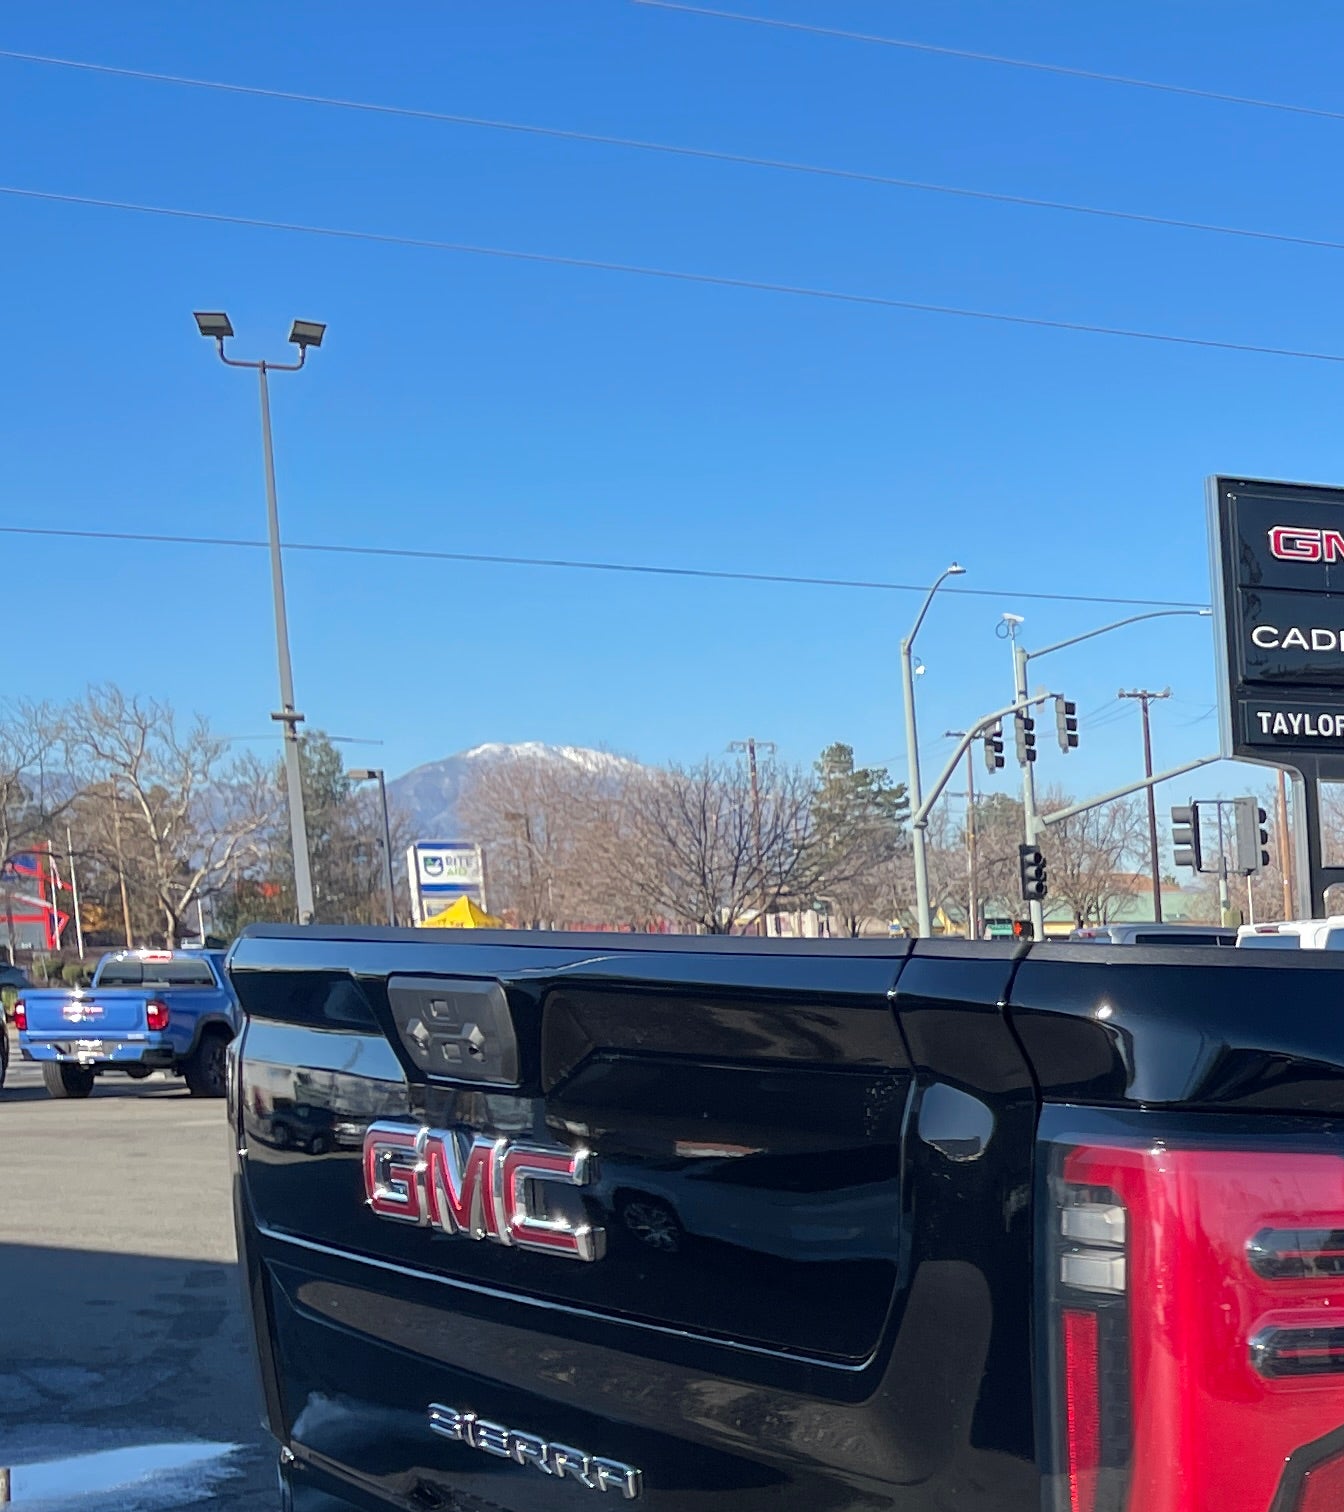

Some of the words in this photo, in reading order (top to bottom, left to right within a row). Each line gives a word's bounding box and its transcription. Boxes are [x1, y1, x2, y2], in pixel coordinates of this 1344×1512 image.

[445, 856, 474, 866] RITE
[447, 867, 468, 876] AID
[362, 1119, 607, 1263] GMC
[428, 1402, 646, 1500] SIERRA
